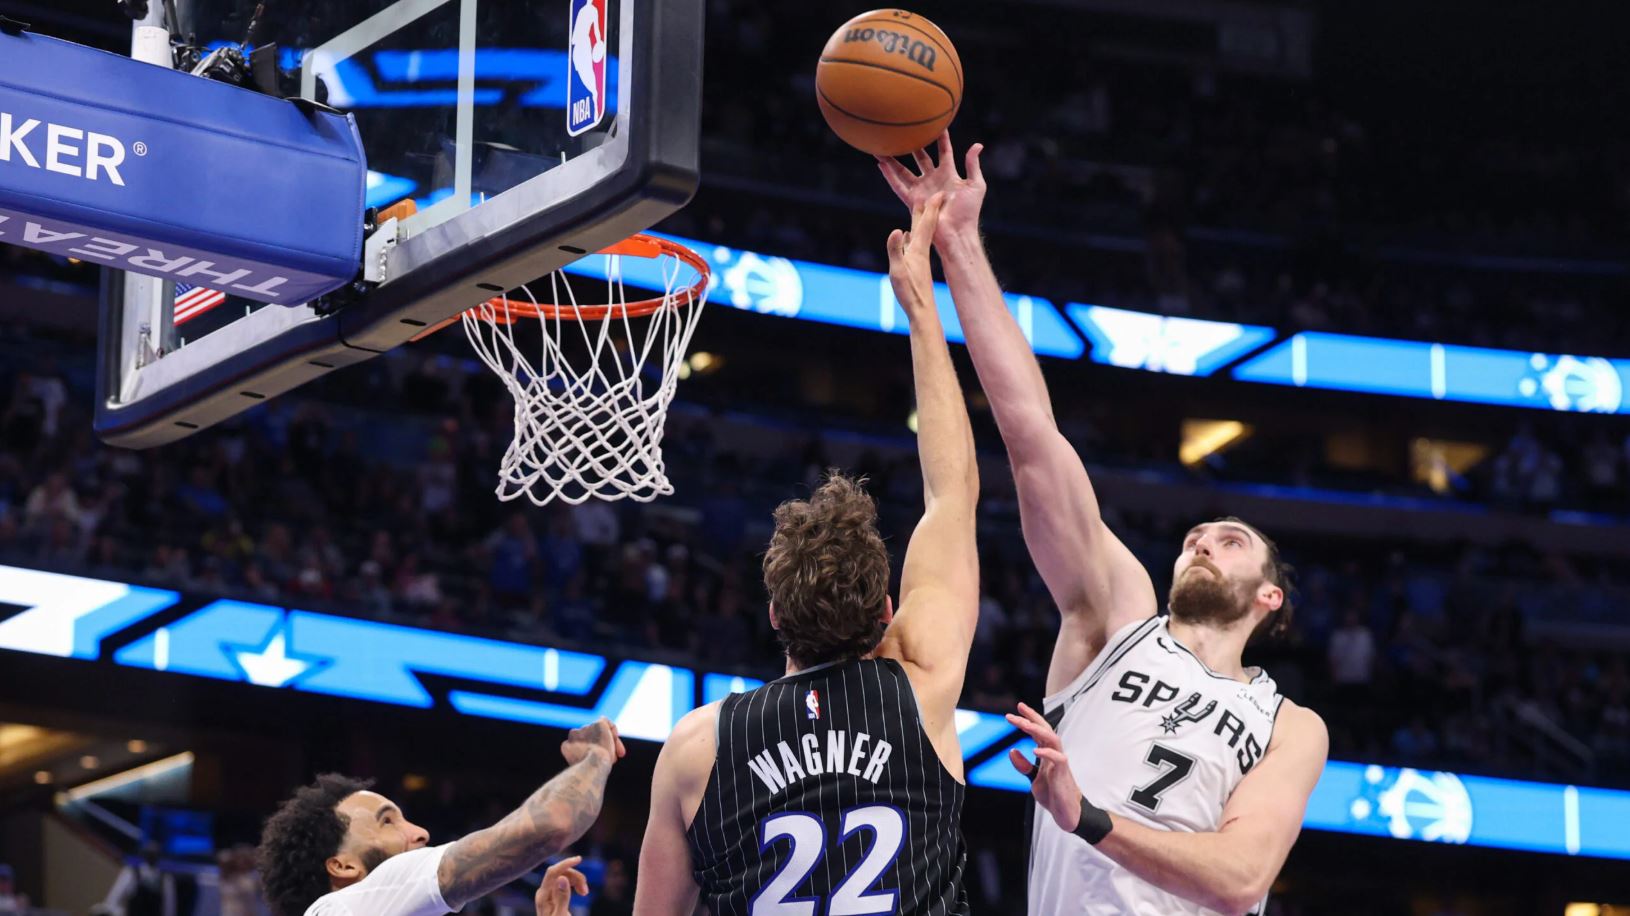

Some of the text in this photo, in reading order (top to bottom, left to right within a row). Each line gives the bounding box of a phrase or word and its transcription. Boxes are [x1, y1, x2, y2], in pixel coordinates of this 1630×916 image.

[844, 28, 937, 72] Wilson
[572, 96, 591, 126] NBA
[0, 215, 289, 297] THREA
[1111, 670, 1263, 775] SPURS
[747, 729, 893, 795] WAGNER
[1126, 740, 1199, 814] 7
[747, 802, 907, 916] 22
